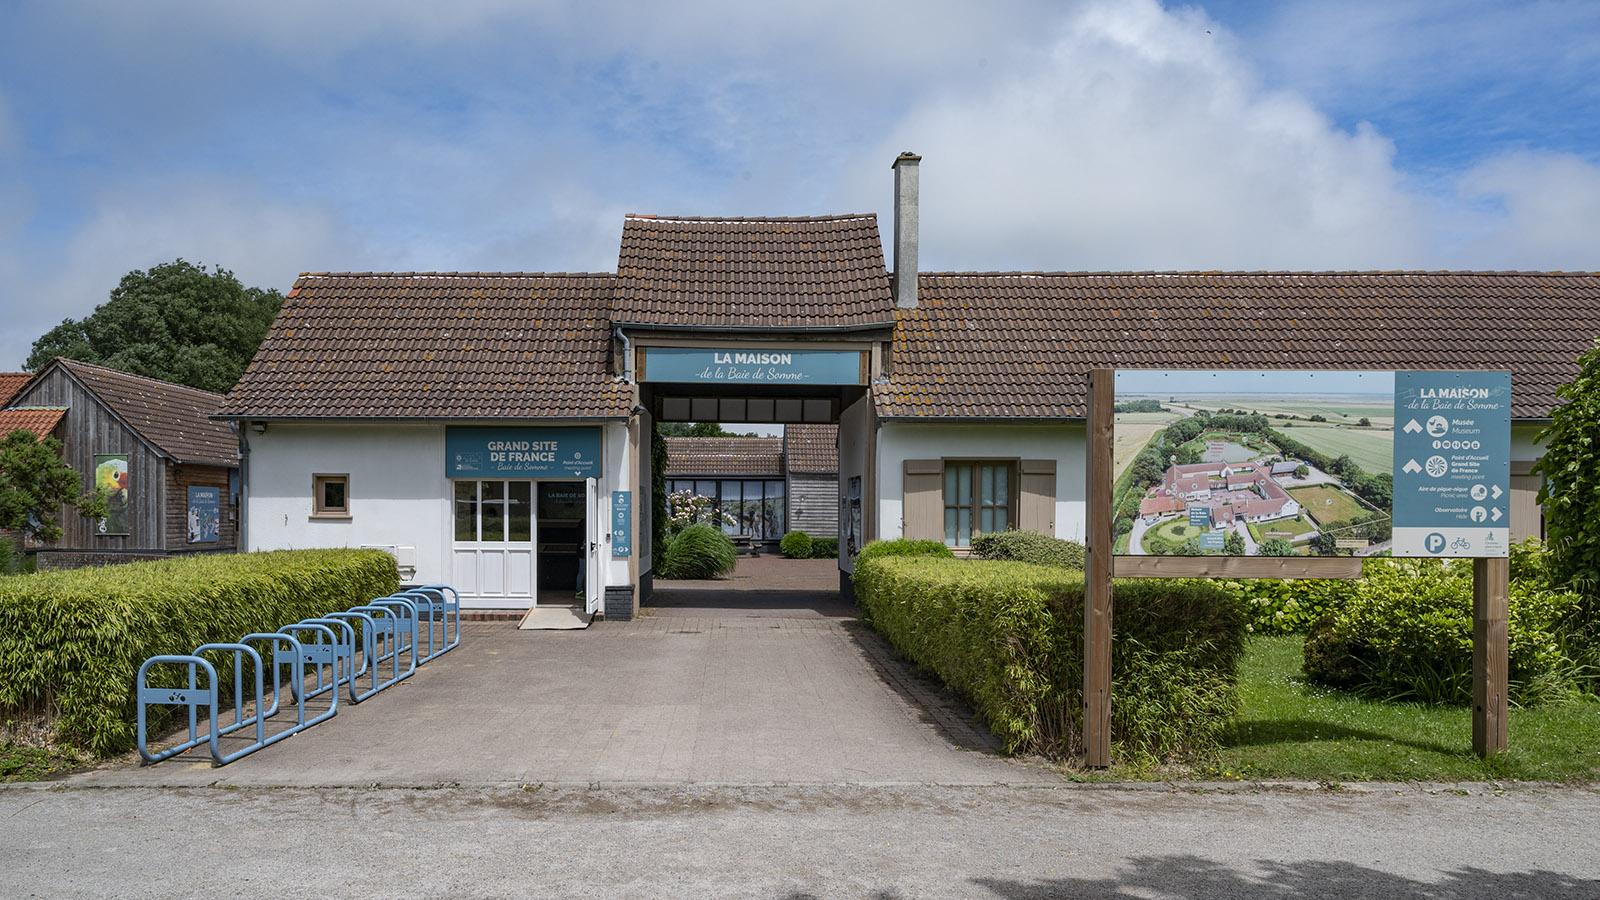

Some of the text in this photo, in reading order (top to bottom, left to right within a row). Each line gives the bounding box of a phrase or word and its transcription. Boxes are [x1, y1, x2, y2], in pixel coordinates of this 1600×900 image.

[714, 353, 791, 364] LA MAISON
[714, 367, 724, 379] la
[728, 367, 750, 379] Baie
[752, 367, 764, 379] de
[1420, 388, 1489, 399] LA MAISON
[1421, 399, 1430, 410] la
[1432, 399, 1452, 410] Baie
[1454, 399, 1465, 410] de
[487, 441, 558, 451] GRAND SITE
[490, 452, 506, 462] DE
[508, 452, 555, 462] FRANCE
[497, 462, 548, 471] Baie de Somme
[1429, 535, 1443, 551] P
